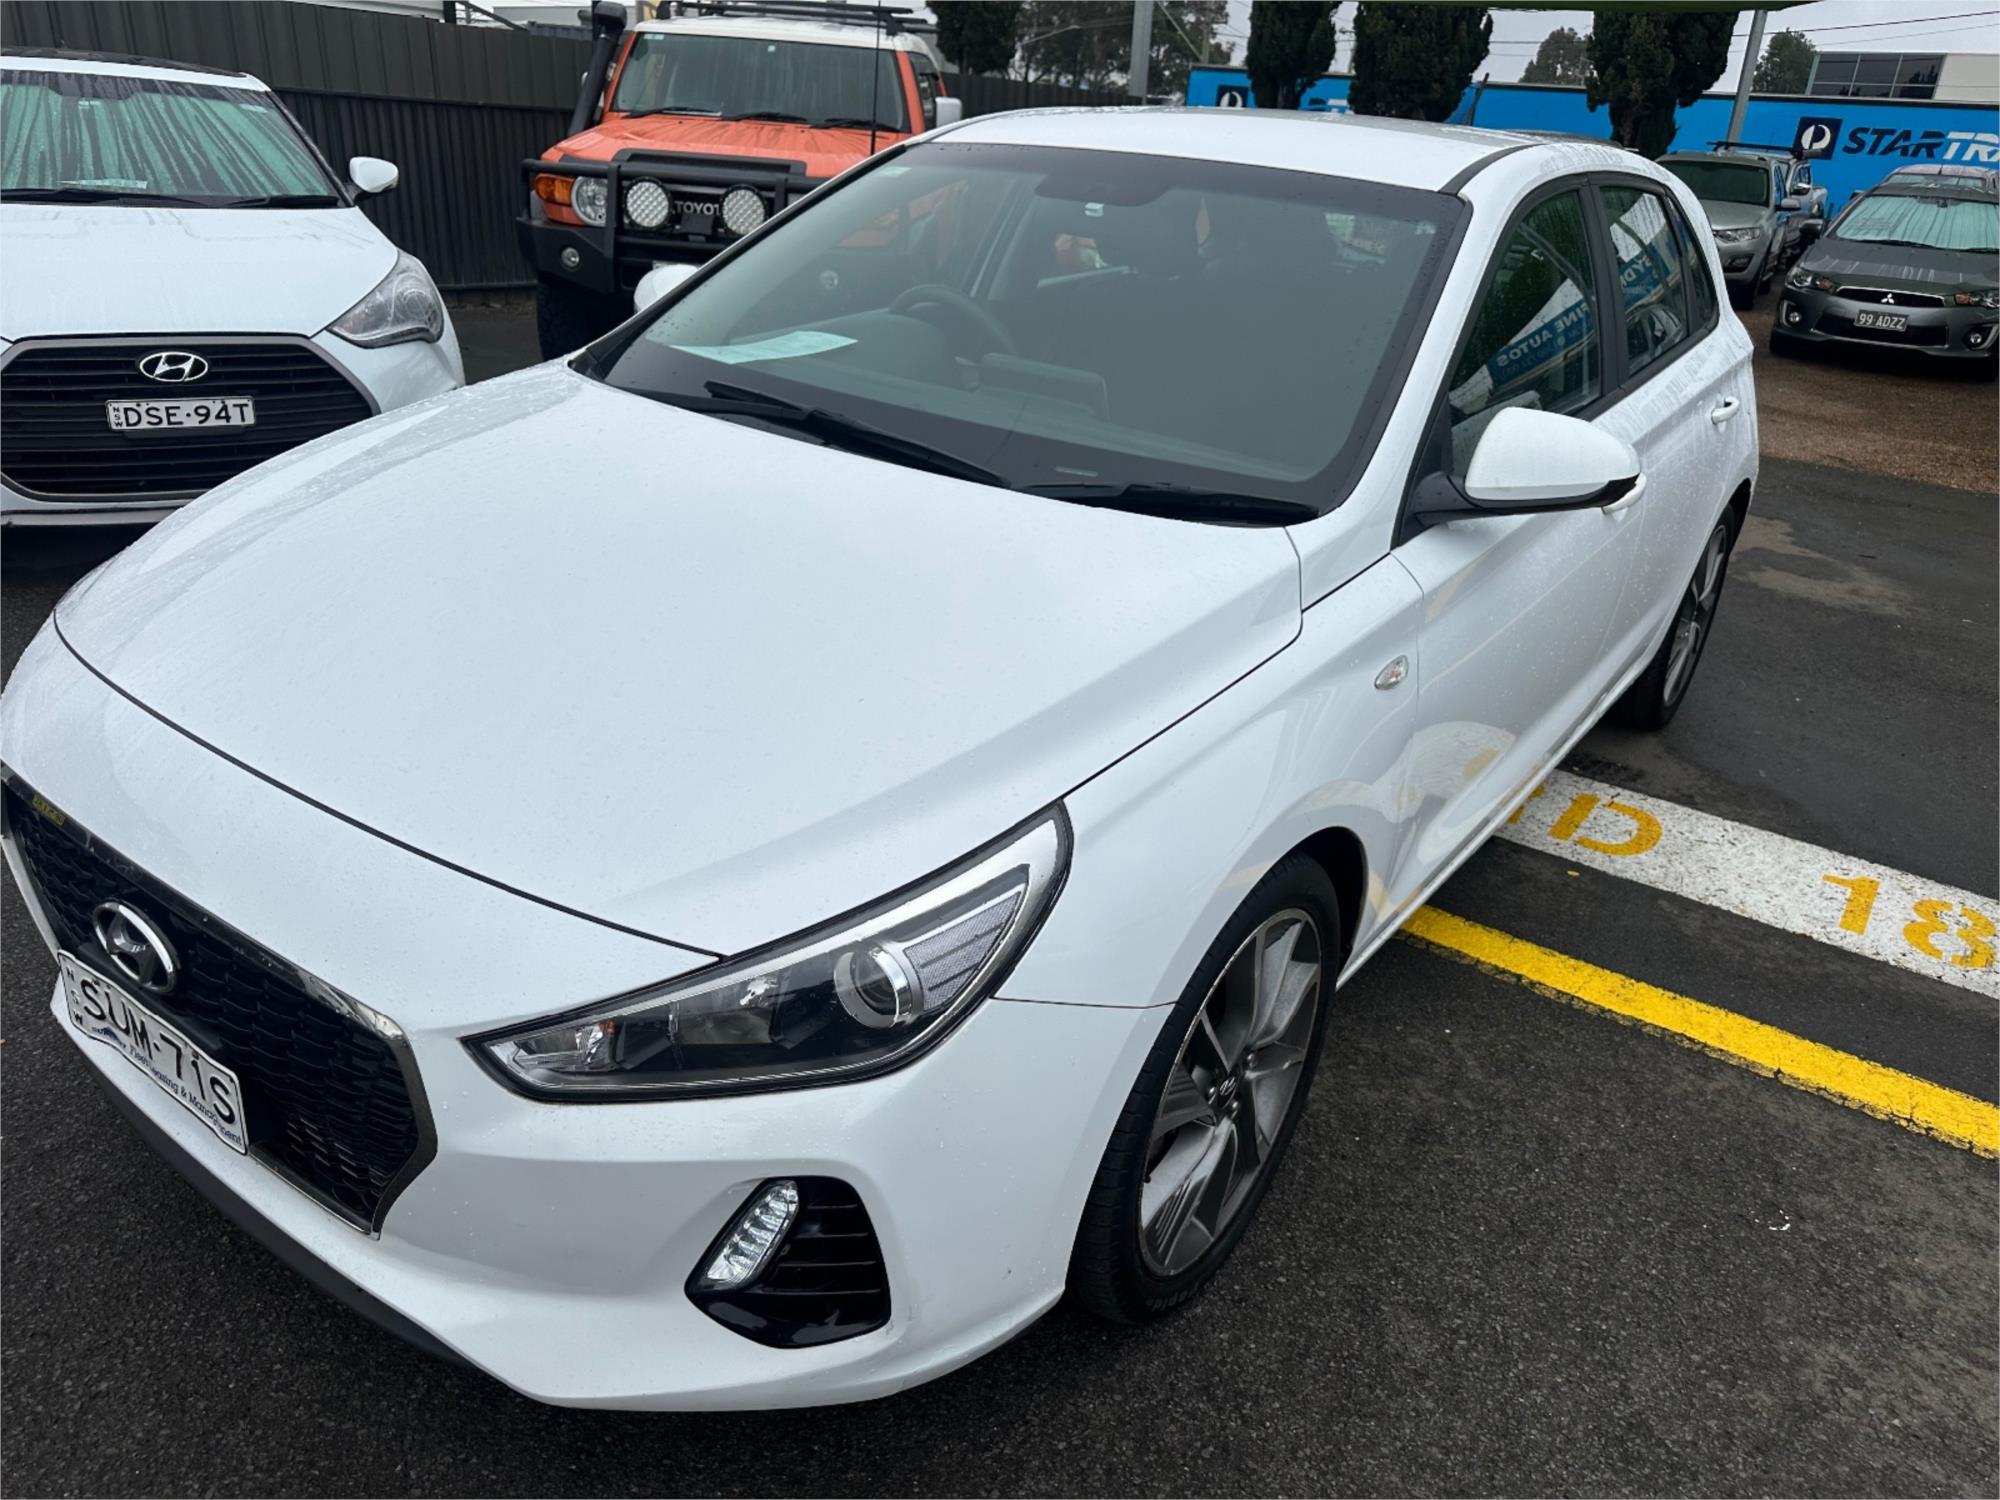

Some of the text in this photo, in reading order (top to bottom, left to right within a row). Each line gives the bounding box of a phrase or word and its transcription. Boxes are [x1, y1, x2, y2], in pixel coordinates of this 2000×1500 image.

[1844, 127, 1999, 161] STARTR
[674, 201, 720, 216] TOYOT
[1859, 313, 1873, 325] 99
[1823, 874, 1997, 969] 18
